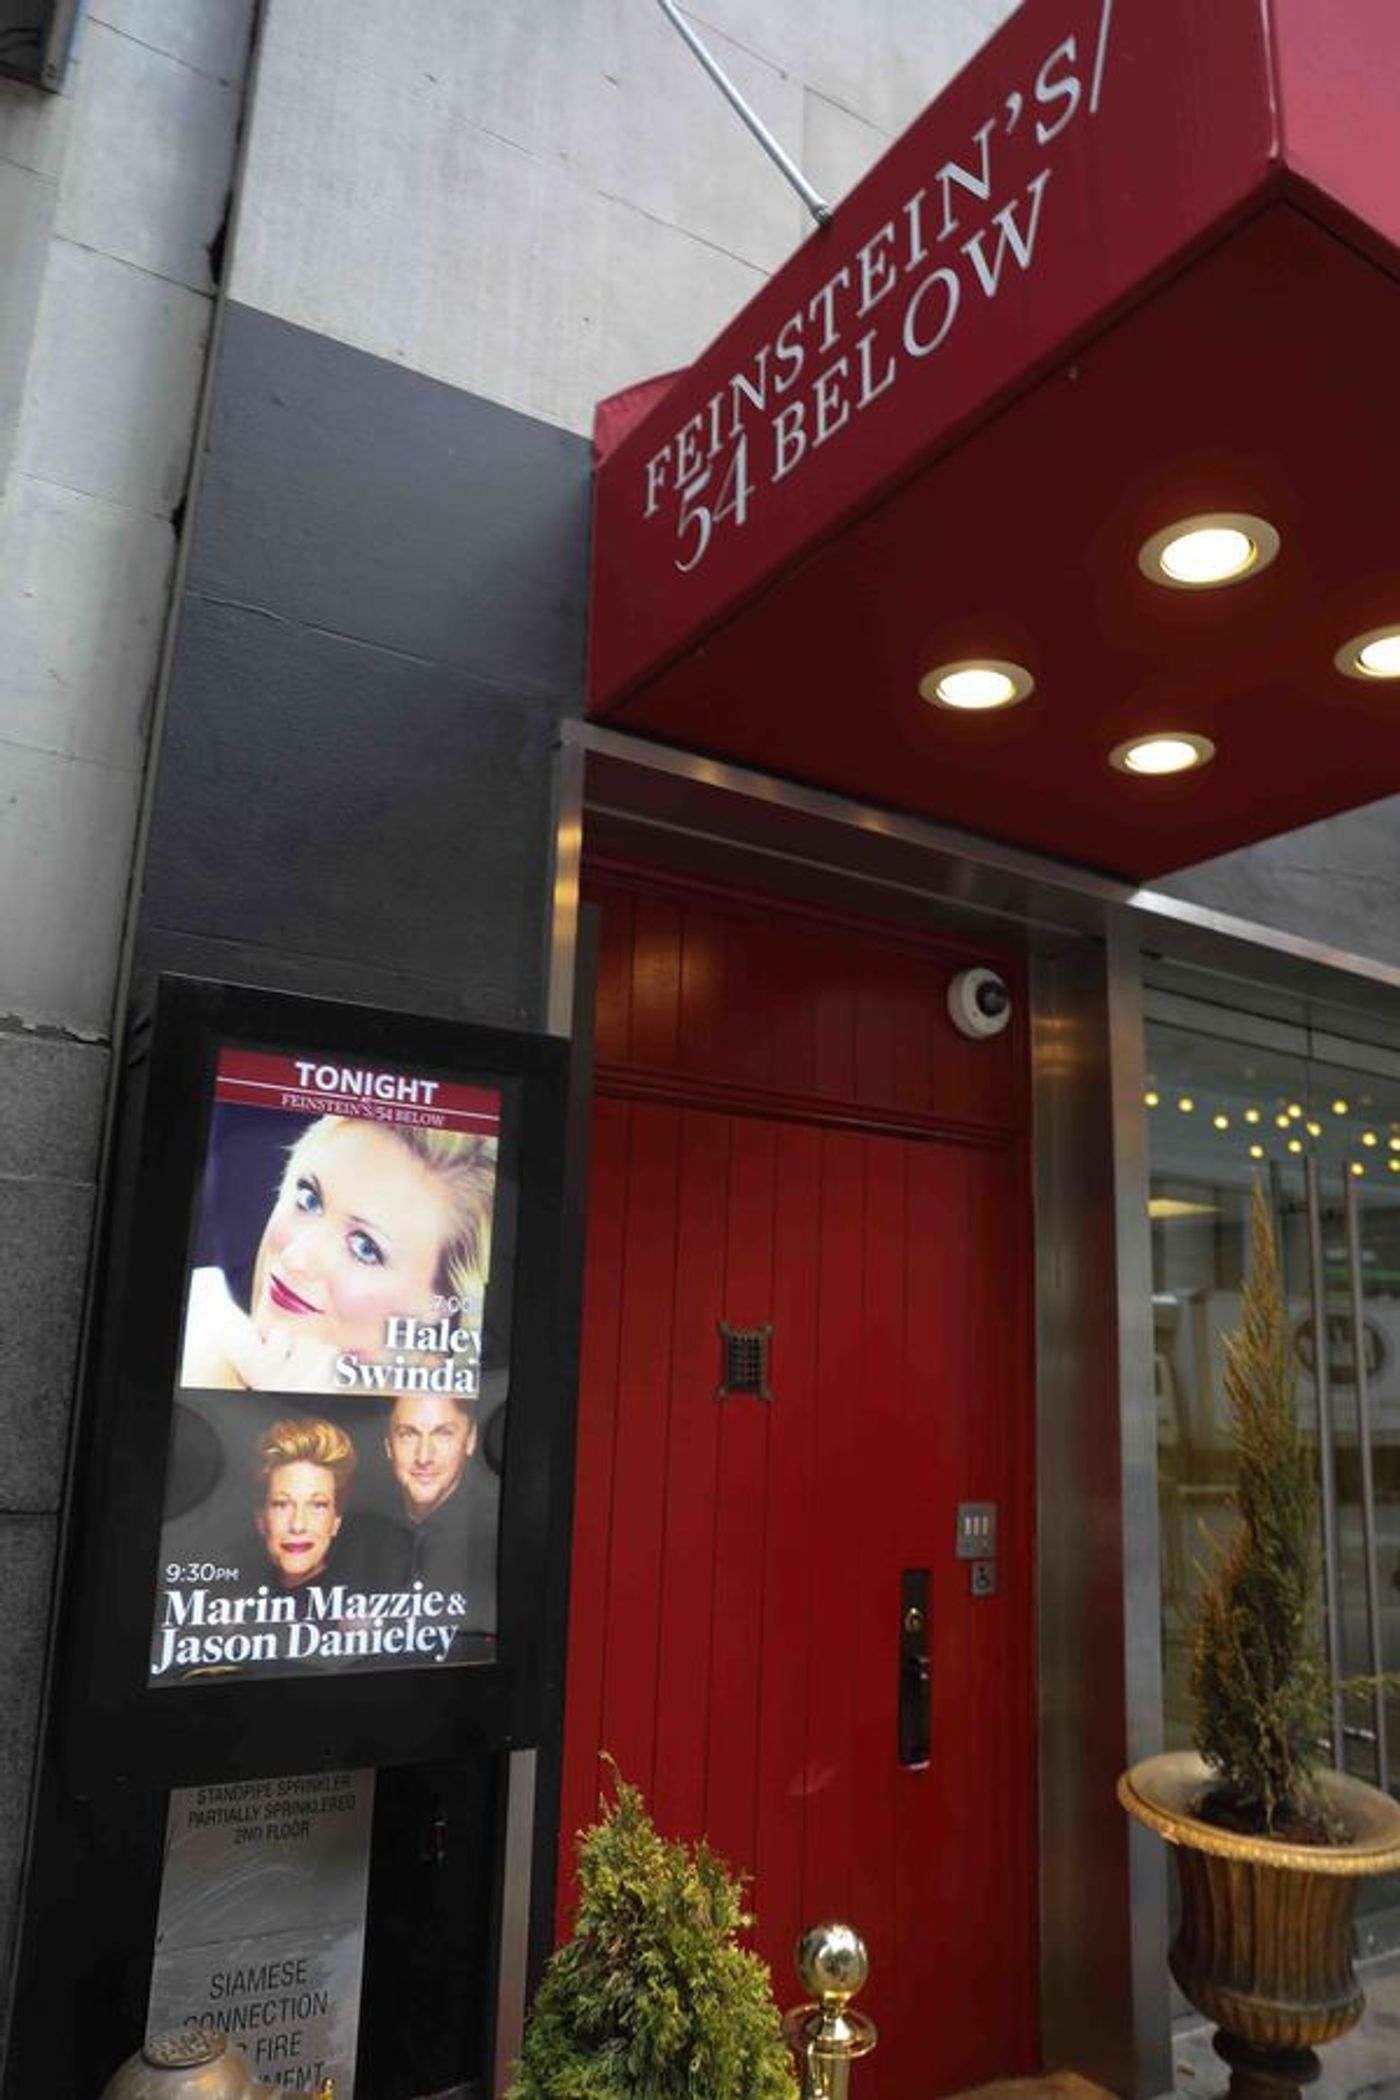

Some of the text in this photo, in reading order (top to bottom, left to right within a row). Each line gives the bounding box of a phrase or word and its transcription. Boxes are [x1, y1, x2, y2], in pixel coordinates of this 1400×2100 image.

[675, 169, 1051, 572] 54 BELOW
[294, 1060, 440, 1105] TONIGHT
[335, 1354, 480, 1392] Swinda
[165, 1562, 239, 1583] 9:30PM
[163, 1585, 296, 1628] Marin
[304, 1580, 444, 1621] Mazzie
[151, 1617, 460, 1675] Jason Danieley
[187, 1805, 262, 1828] PARTIALLY
[233, 1819, 310, 1845] 2ND FLOOR
[209, 1959, 308, 2000] SIAMESE
[255, 2031, 303, 2064] FIRE
